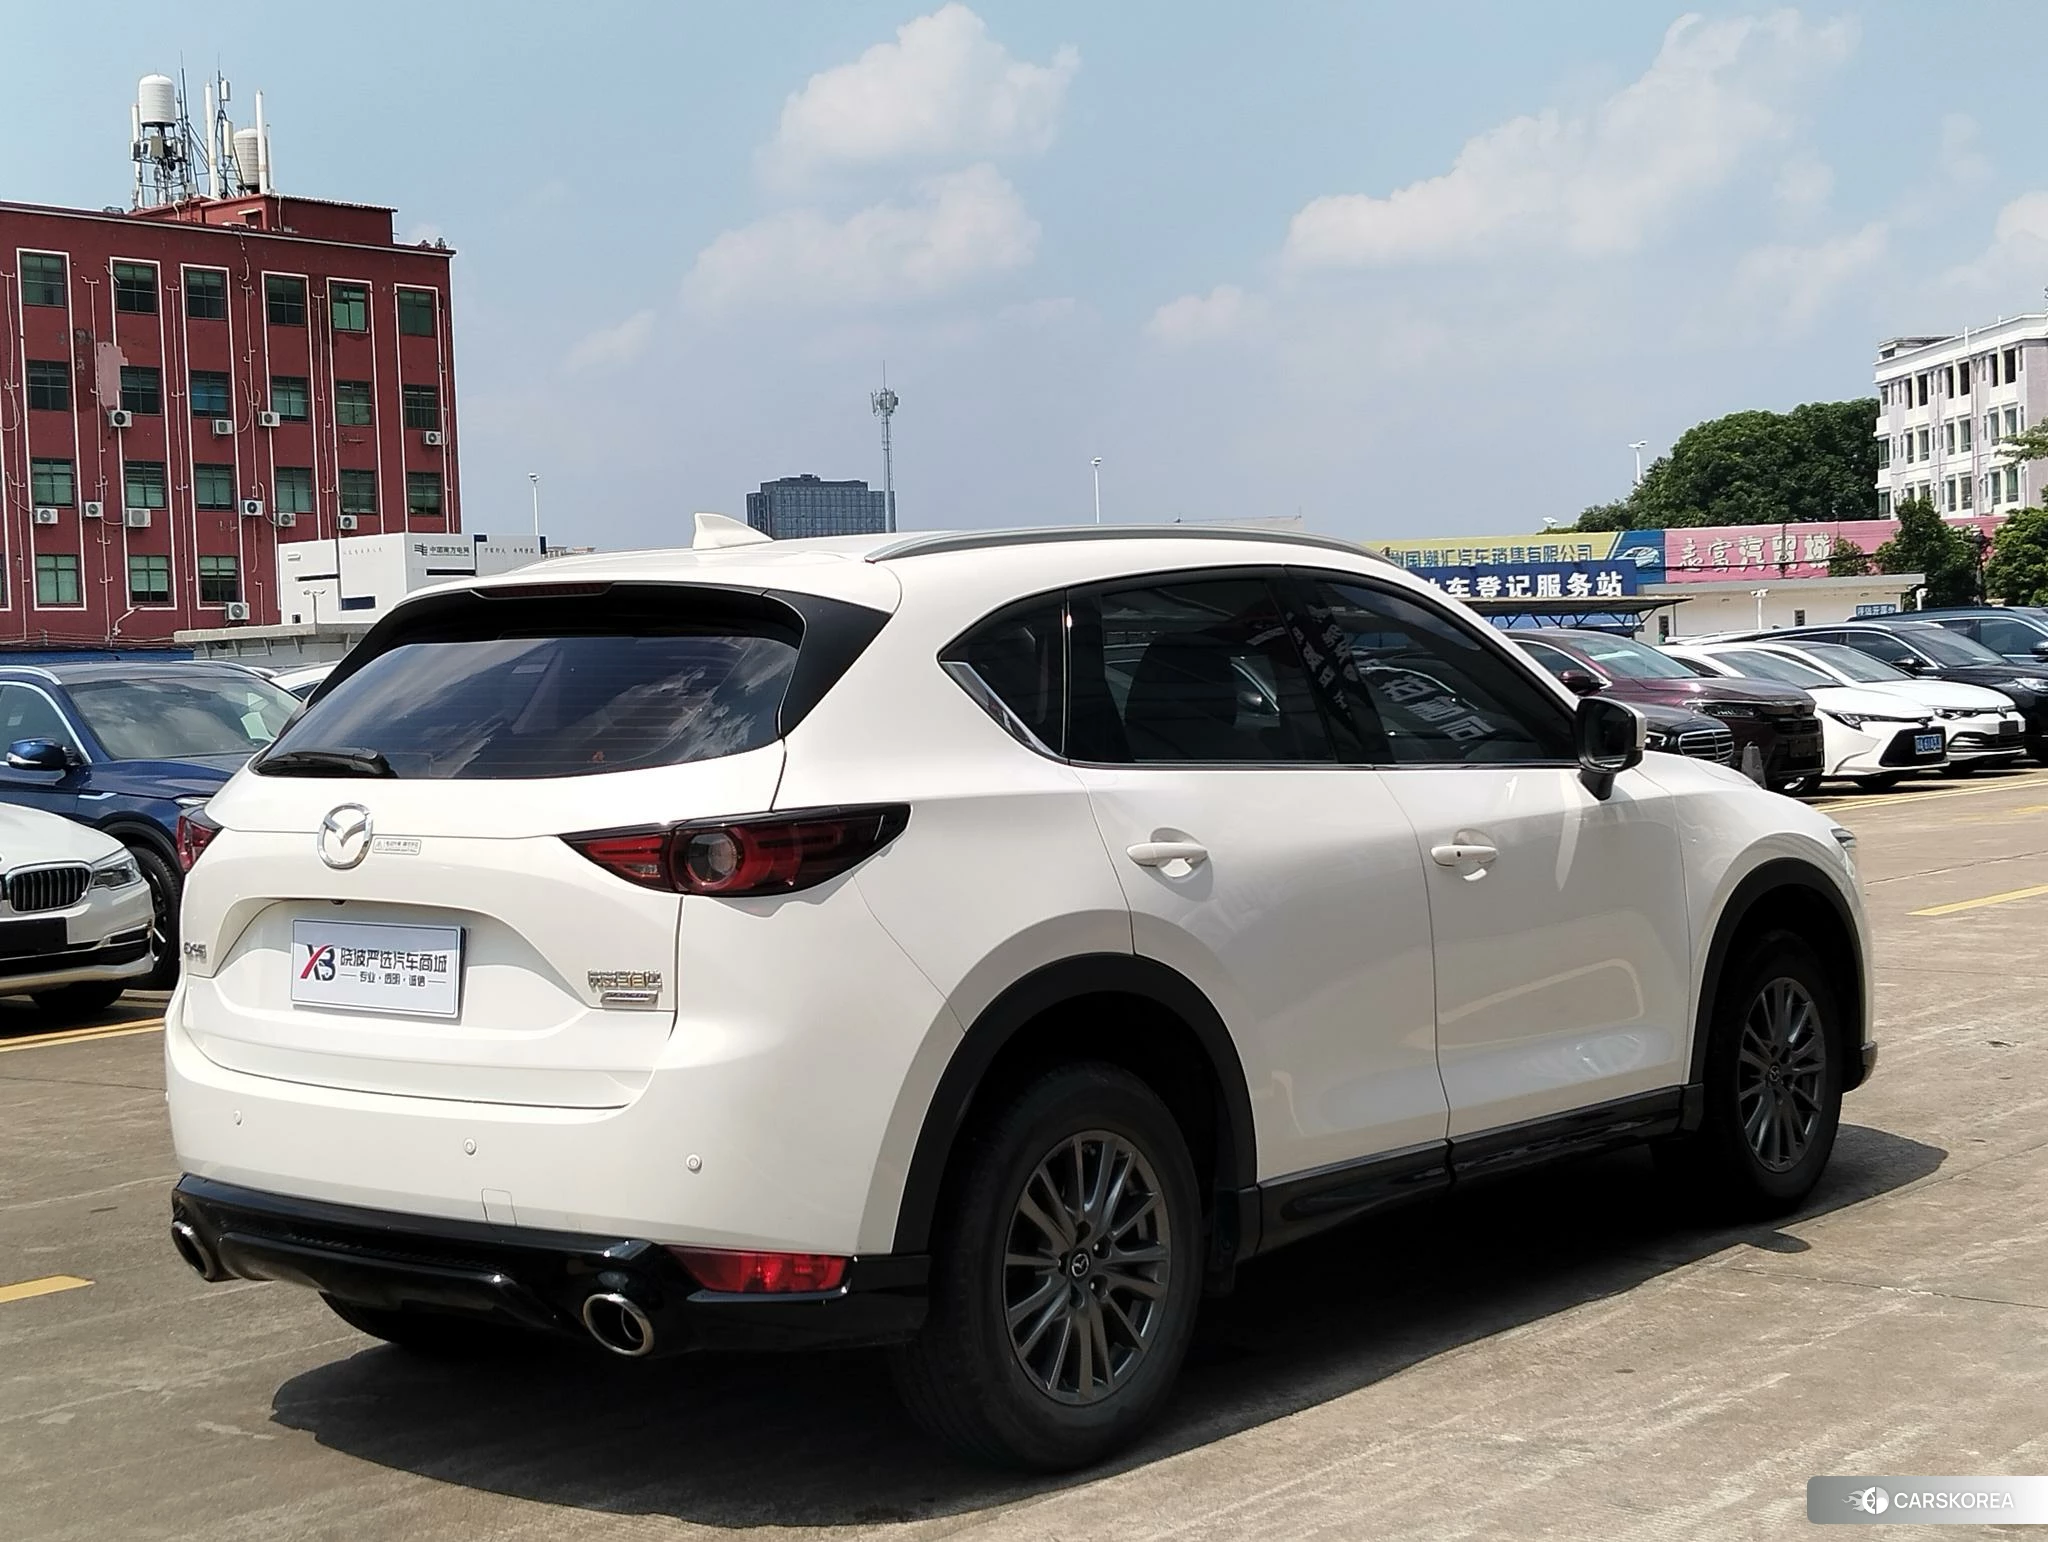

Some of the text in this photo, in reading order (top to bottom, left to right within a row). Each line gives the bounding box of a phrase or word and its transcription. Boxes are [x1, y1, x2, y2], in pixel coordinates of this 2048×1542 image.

[340, 947, 448, 973] 晓波严选汽车商城
